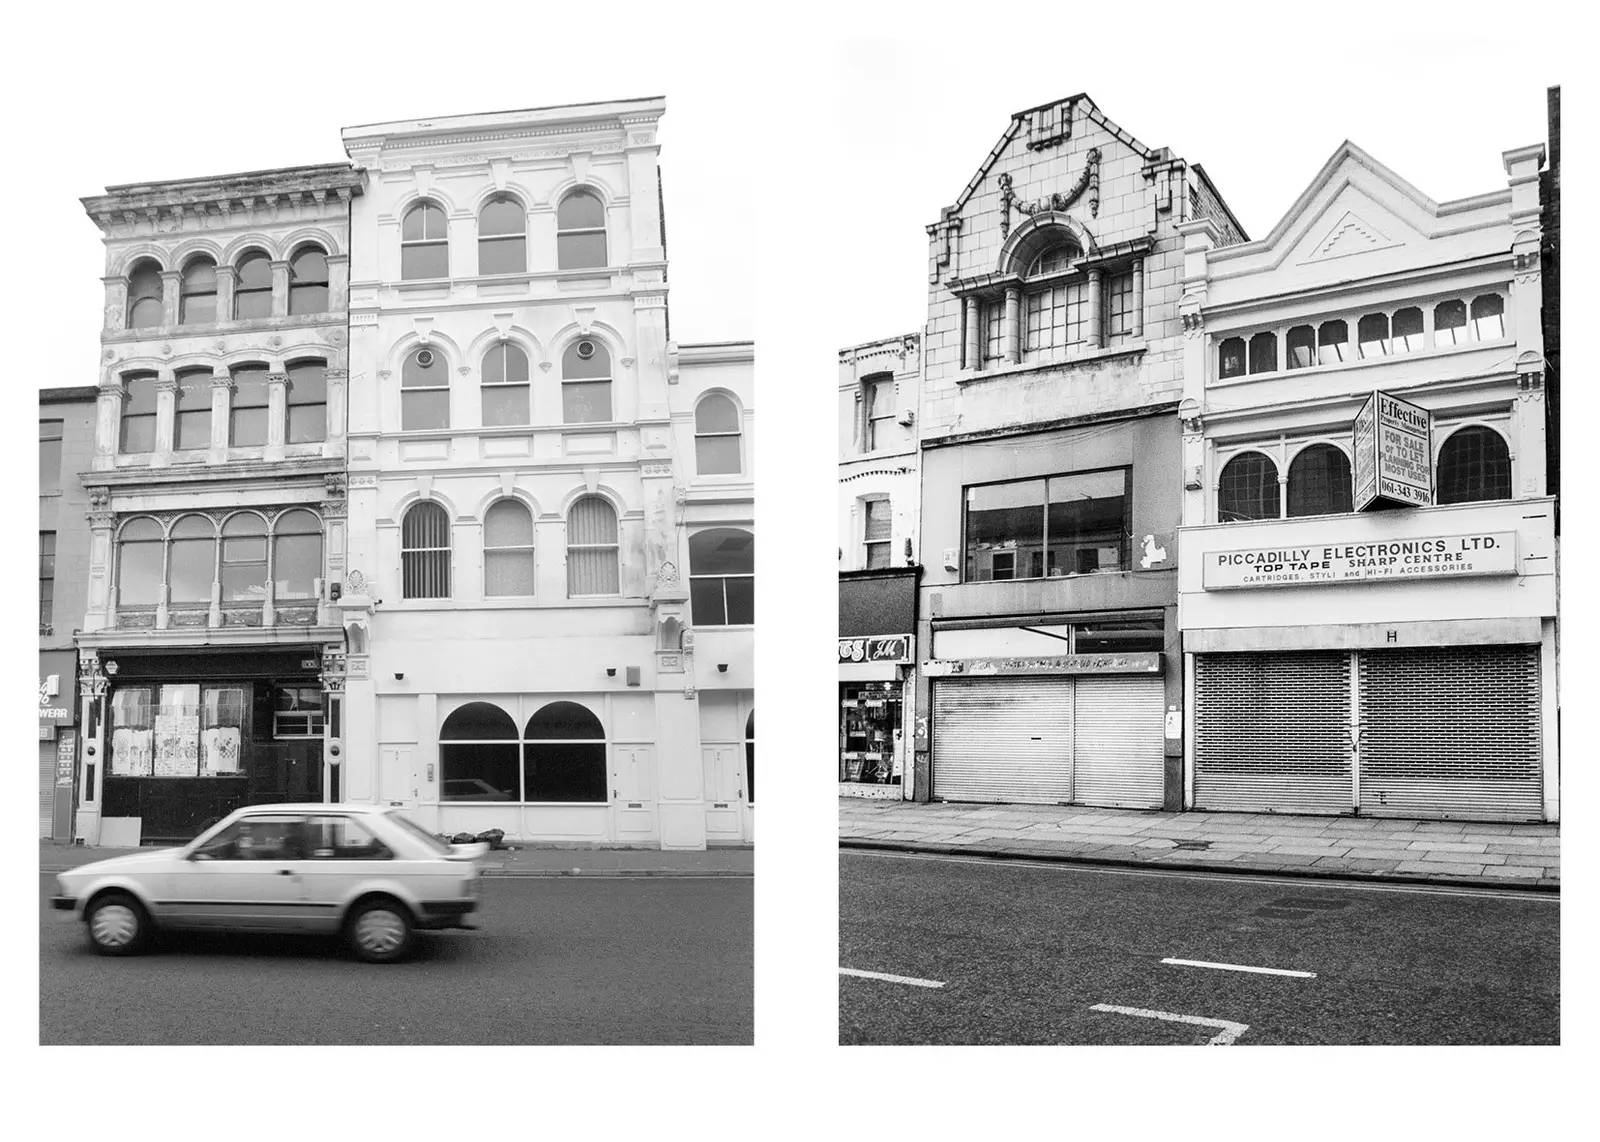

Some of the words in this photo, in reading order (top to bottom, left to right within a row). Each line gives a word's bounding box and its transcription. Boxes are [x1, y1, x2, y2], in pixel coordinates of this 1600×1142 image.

[1381, 398, 1427, 429] Effective
[1381, 414, 1400, 427] Property
[1385, 430, 1401, 446] FOR
[1404, 436, 1424, 453] SALE
[1380, 451, 1414, 470] PLANNING
[1416, 463, 1430, 475] FOR
[1385, 445, 1394, 454] or
[1396, 446, 1408, 458] TO
[1410, 450, 1424, 464] LET
[1385, 462, 1406, 476] MOST
[1407, 469, 1426, 483] USES
[1382, 480, 1411, 498] 061-343
[1413, 489, 1430, 503] 3916
[1218, 549, 1311, 566] PICCADILLY
[1323, 541, 1447, 560] ELECTRONICS
[1461, 536, 1501, 551] LTD.
[1348, 557, 1398, 568] SHARP
[1404, 552, 1464, 564] CENTRE
[1254, 564, 1284, 573] TOP
[1289, 561, 1330, 571] TAPE
[1309, 571, 1336, 579] STYLI
[1367, 567, 1394, 576] HI-FI
[1400, 563, 1474, 574] ACCESSORIES
